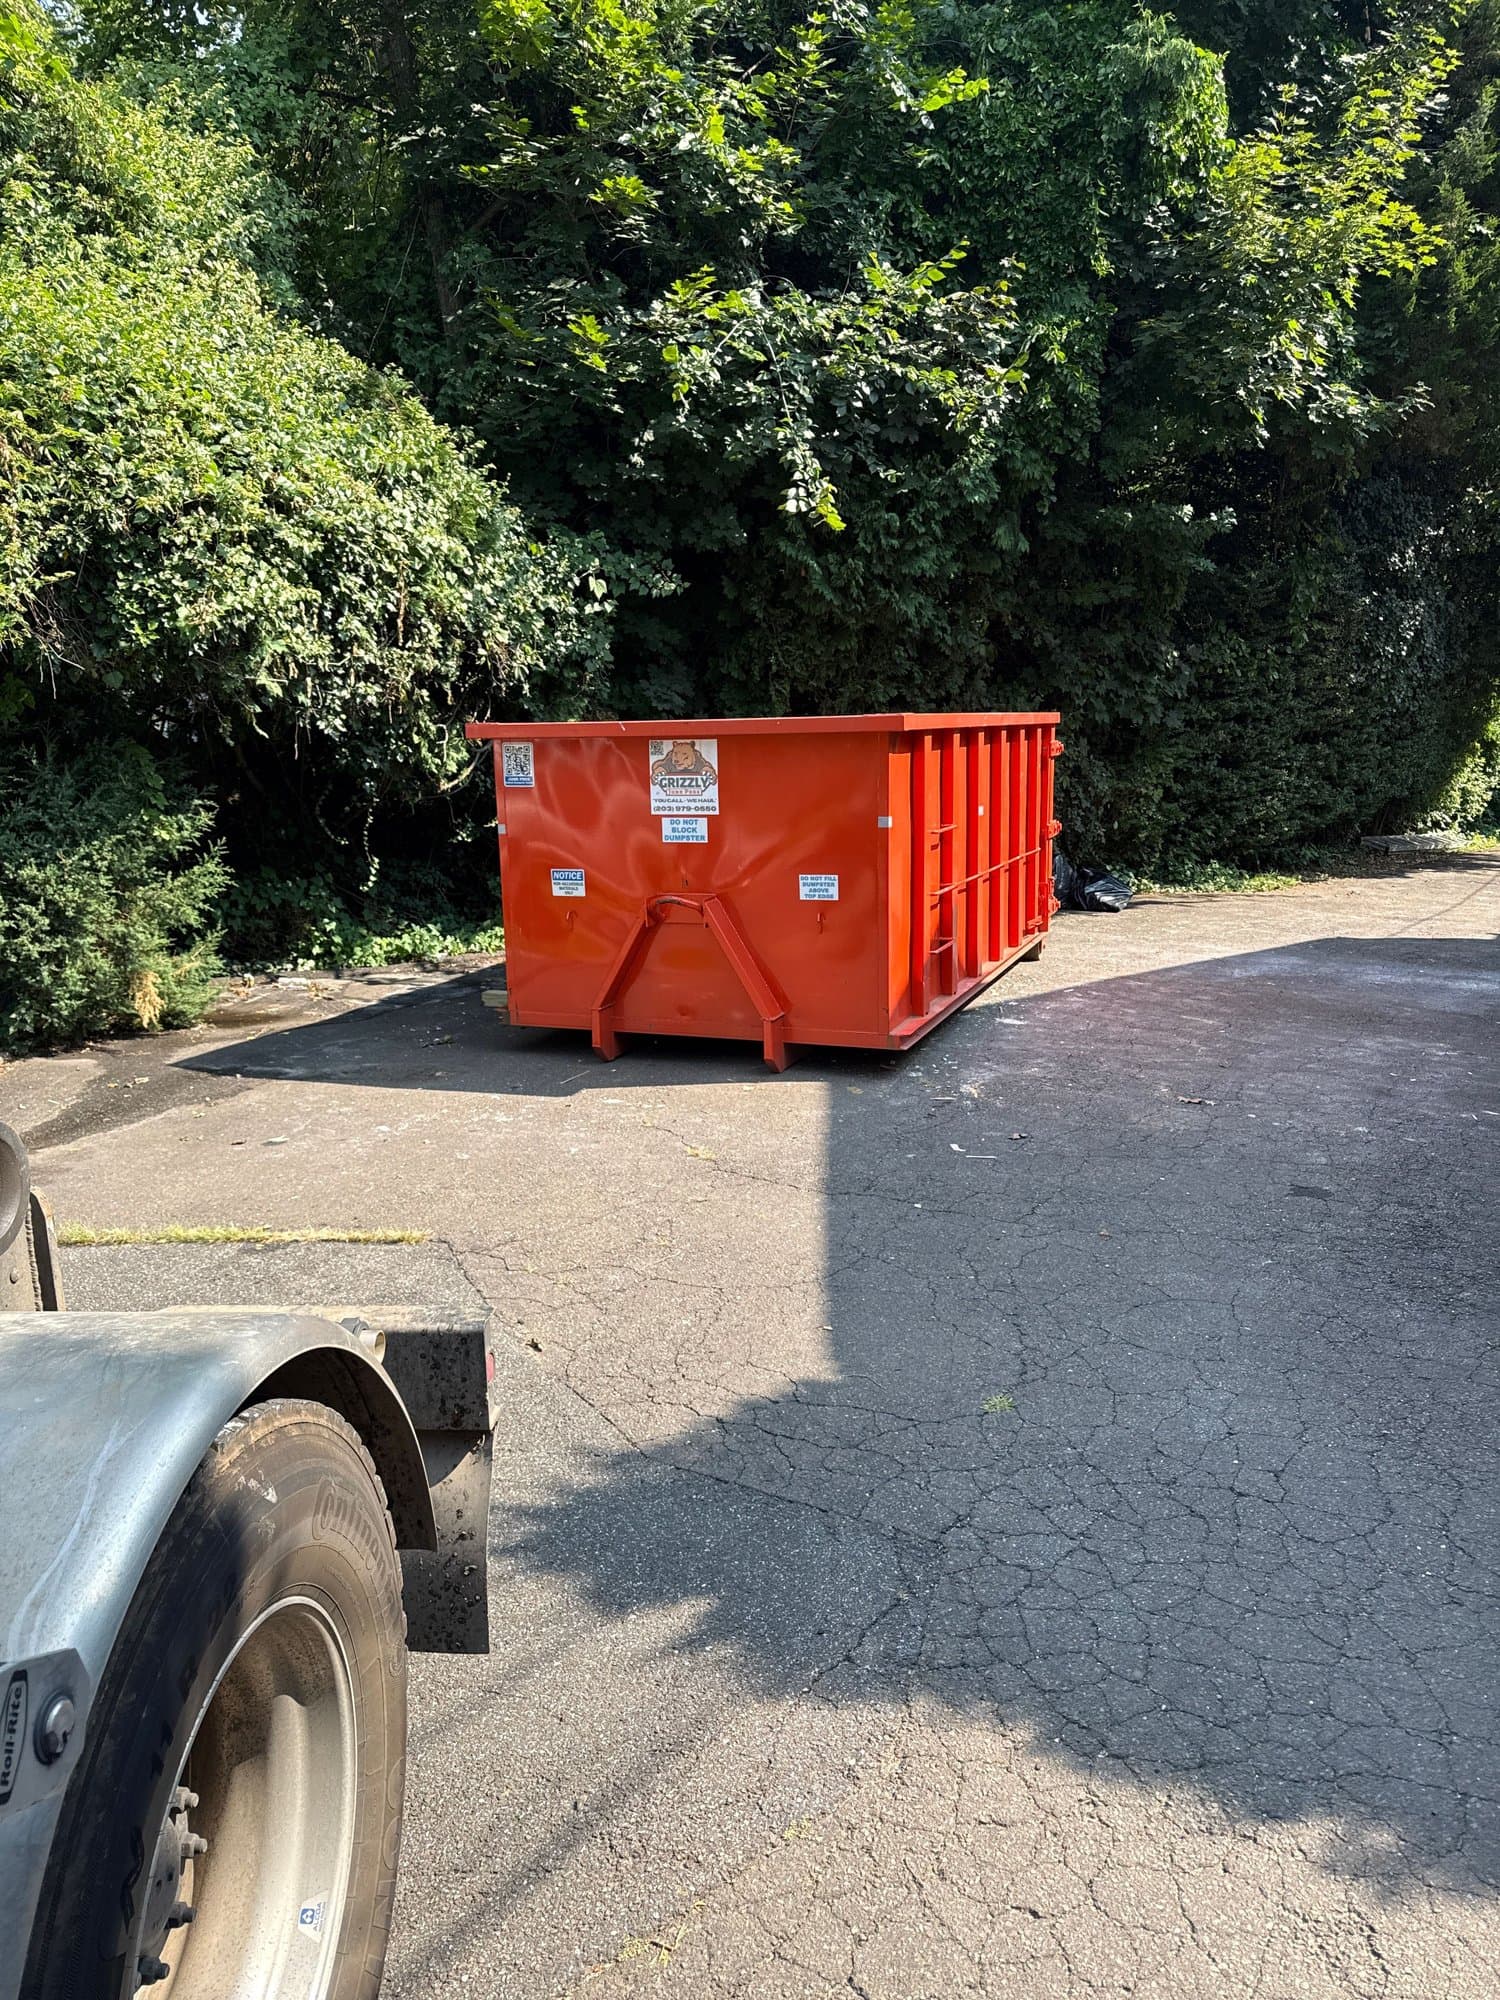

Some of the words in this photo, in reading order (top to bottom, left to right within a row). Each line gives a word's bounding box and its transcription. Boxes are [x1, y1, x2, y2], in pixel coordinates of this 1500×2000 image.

[660, 777, 708, 788] GRIZZLY
[553, 872, 582, 880] NOTICE
[0, 1687, 23, 1787] Roll-Rite
